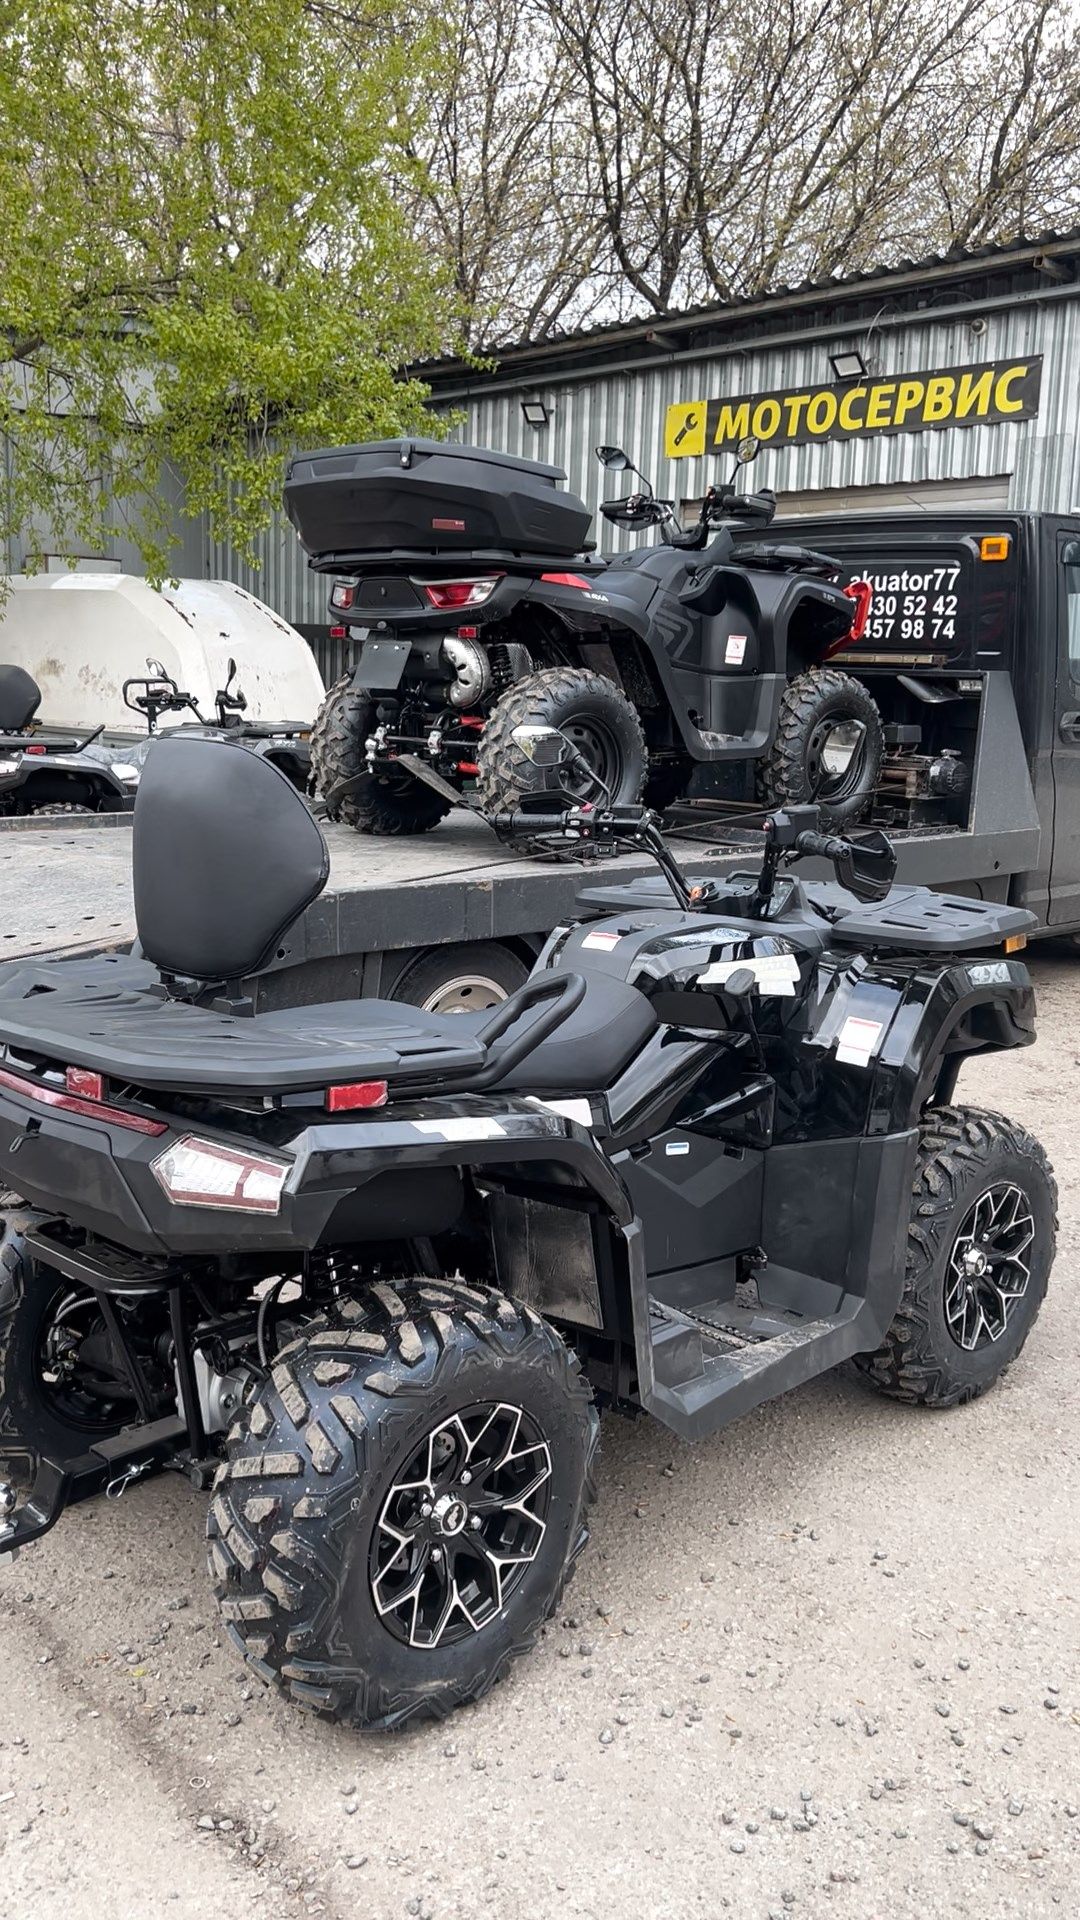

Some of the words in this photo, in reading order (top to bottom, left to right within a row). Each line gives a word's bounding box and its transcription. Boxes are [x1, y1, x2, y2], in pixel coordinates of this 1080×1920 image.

[714, 366, 1028, 445] МОТОСЕРВИС
[902, 596, 927, 616] 52
[932, 595, 958, 616] 42
[900, 619, 924, 639] 98
[931, 619, 955, 639] 74
